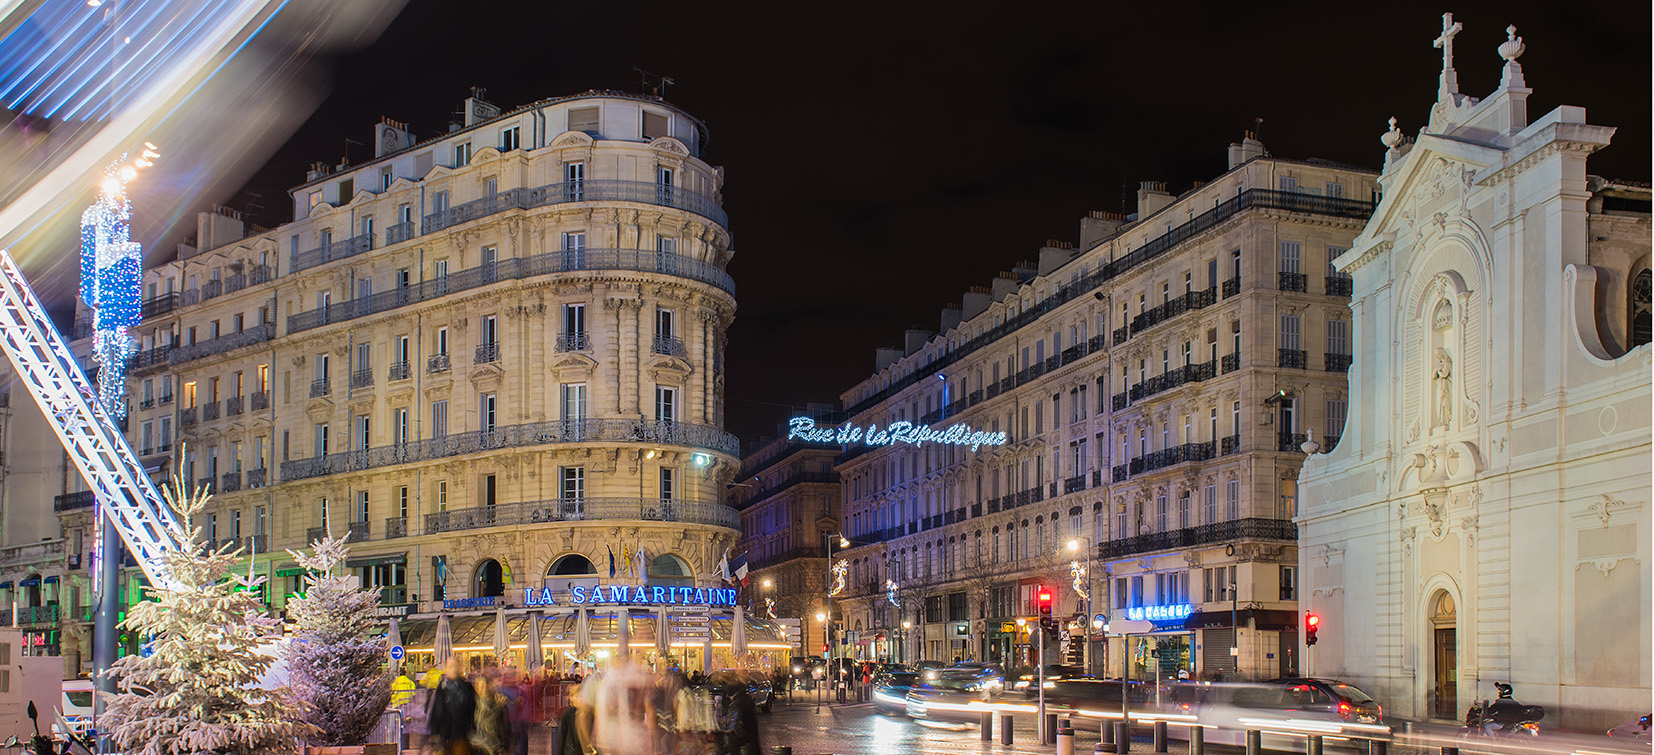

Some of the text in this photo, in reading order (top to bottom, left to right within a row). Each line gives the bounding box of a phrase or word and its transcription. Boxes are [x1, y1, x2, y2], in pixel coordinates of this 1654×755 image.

[788, 416, 835, 443] Rue
[836, 421, 863, 444] de
[865, 423, 891, 446] la
[443, 596, 495, 609] BRASSERIE
[524, 585, 737, 606] LA SAMARITAINE
[1128, 607, 1144, 619] LA
